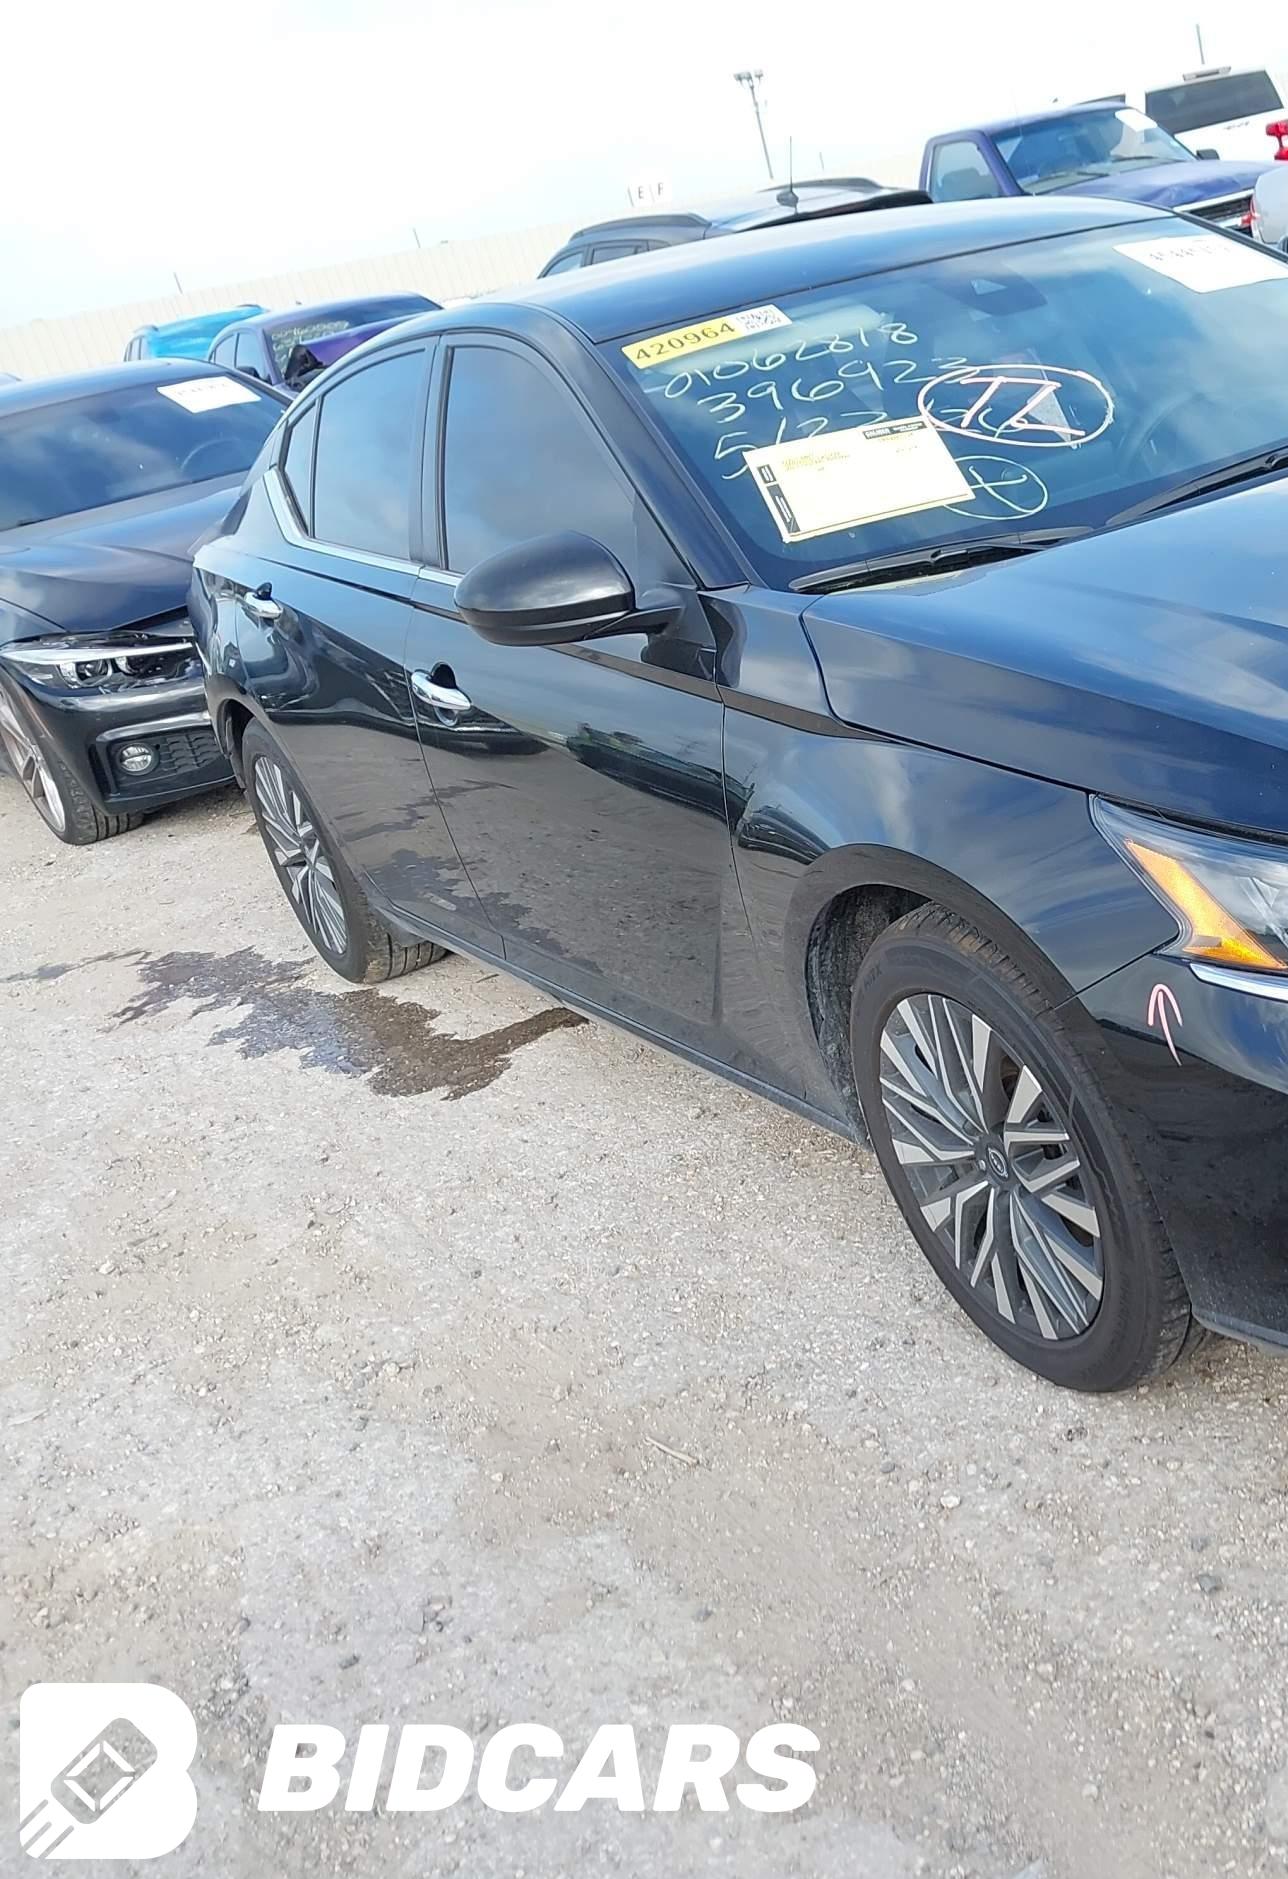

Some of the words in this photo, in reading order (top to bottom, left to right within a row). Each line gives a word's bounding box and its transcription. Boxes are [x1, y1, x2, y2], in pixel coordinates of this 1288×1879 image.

[636, 322, 736, 360] 420964
[664, 322, 918, 399] 01062818
[696, 356, 981, 423] 396923
